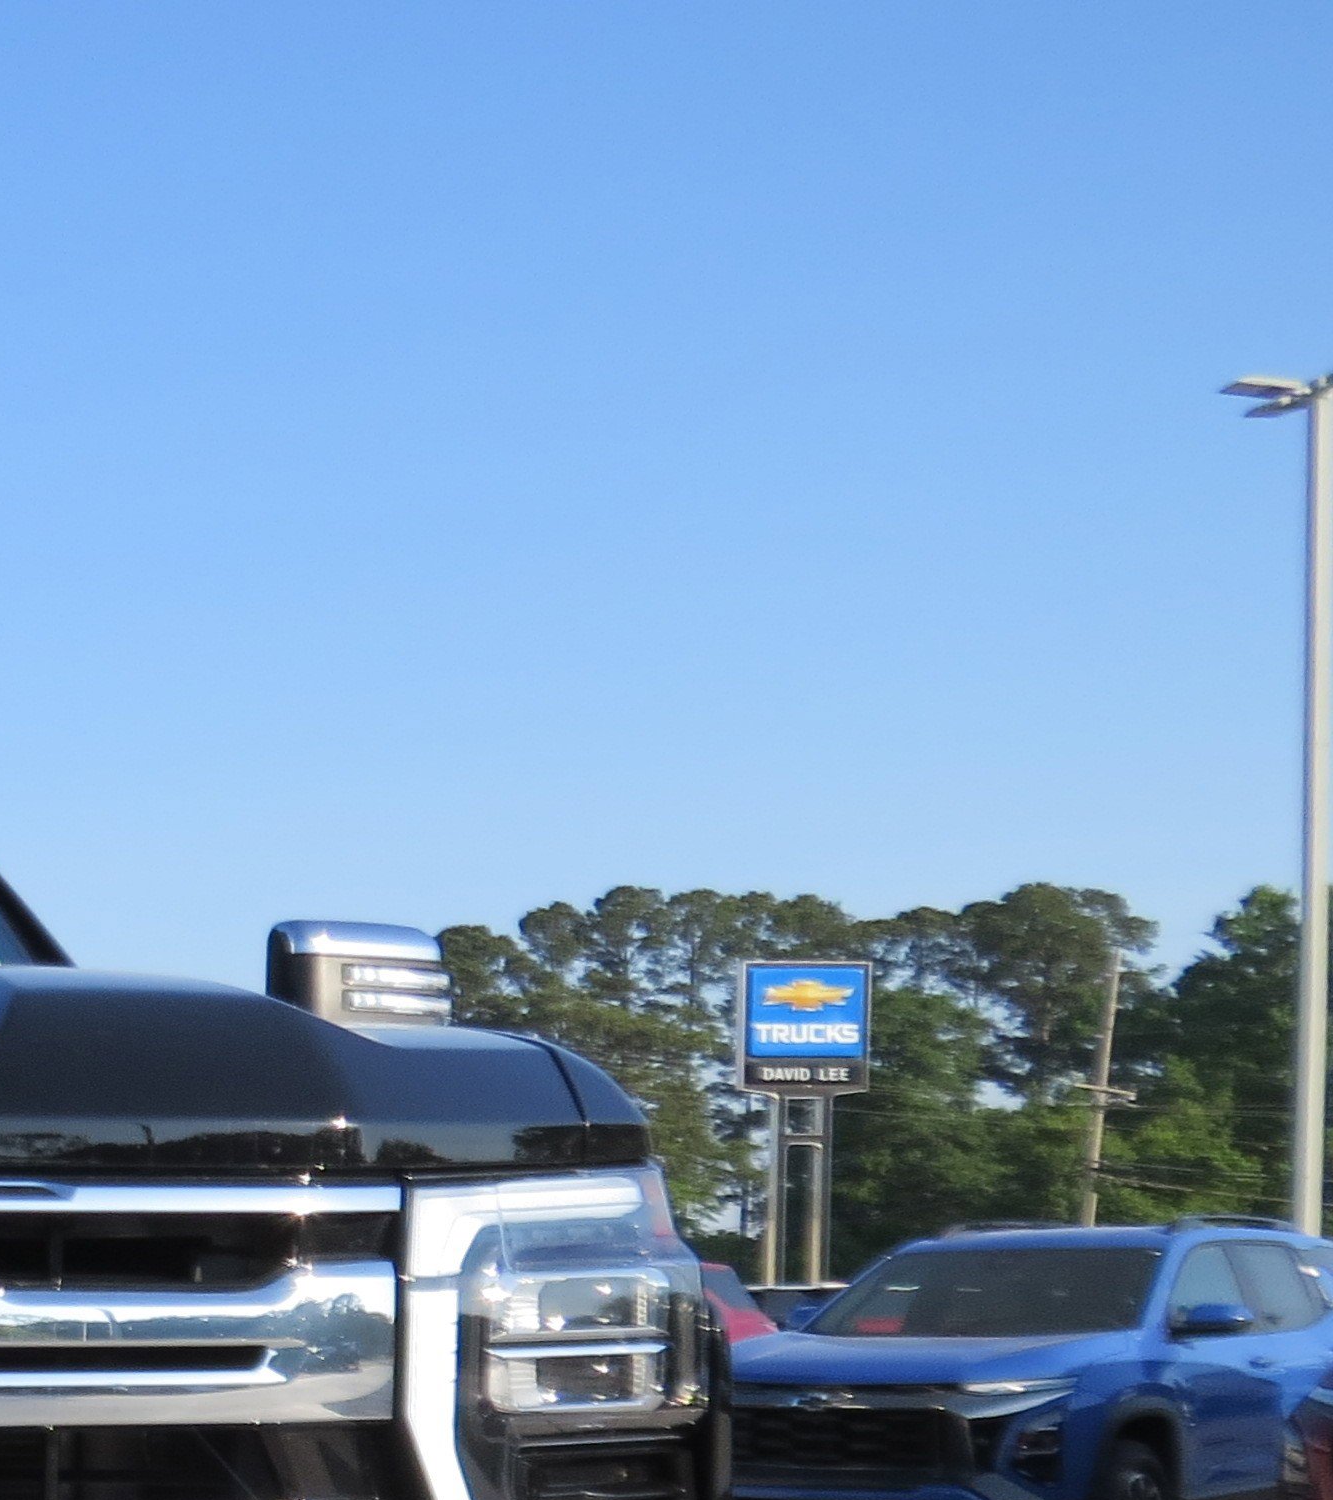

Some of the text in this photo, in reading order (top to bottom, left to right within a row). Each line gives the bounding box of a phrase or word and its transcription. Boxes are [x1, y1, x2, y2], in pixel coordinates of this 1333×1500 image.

[753, 1023, 859, 1044] TRUCKS
[761, 1066, 850, 1082] DAVID LEE
